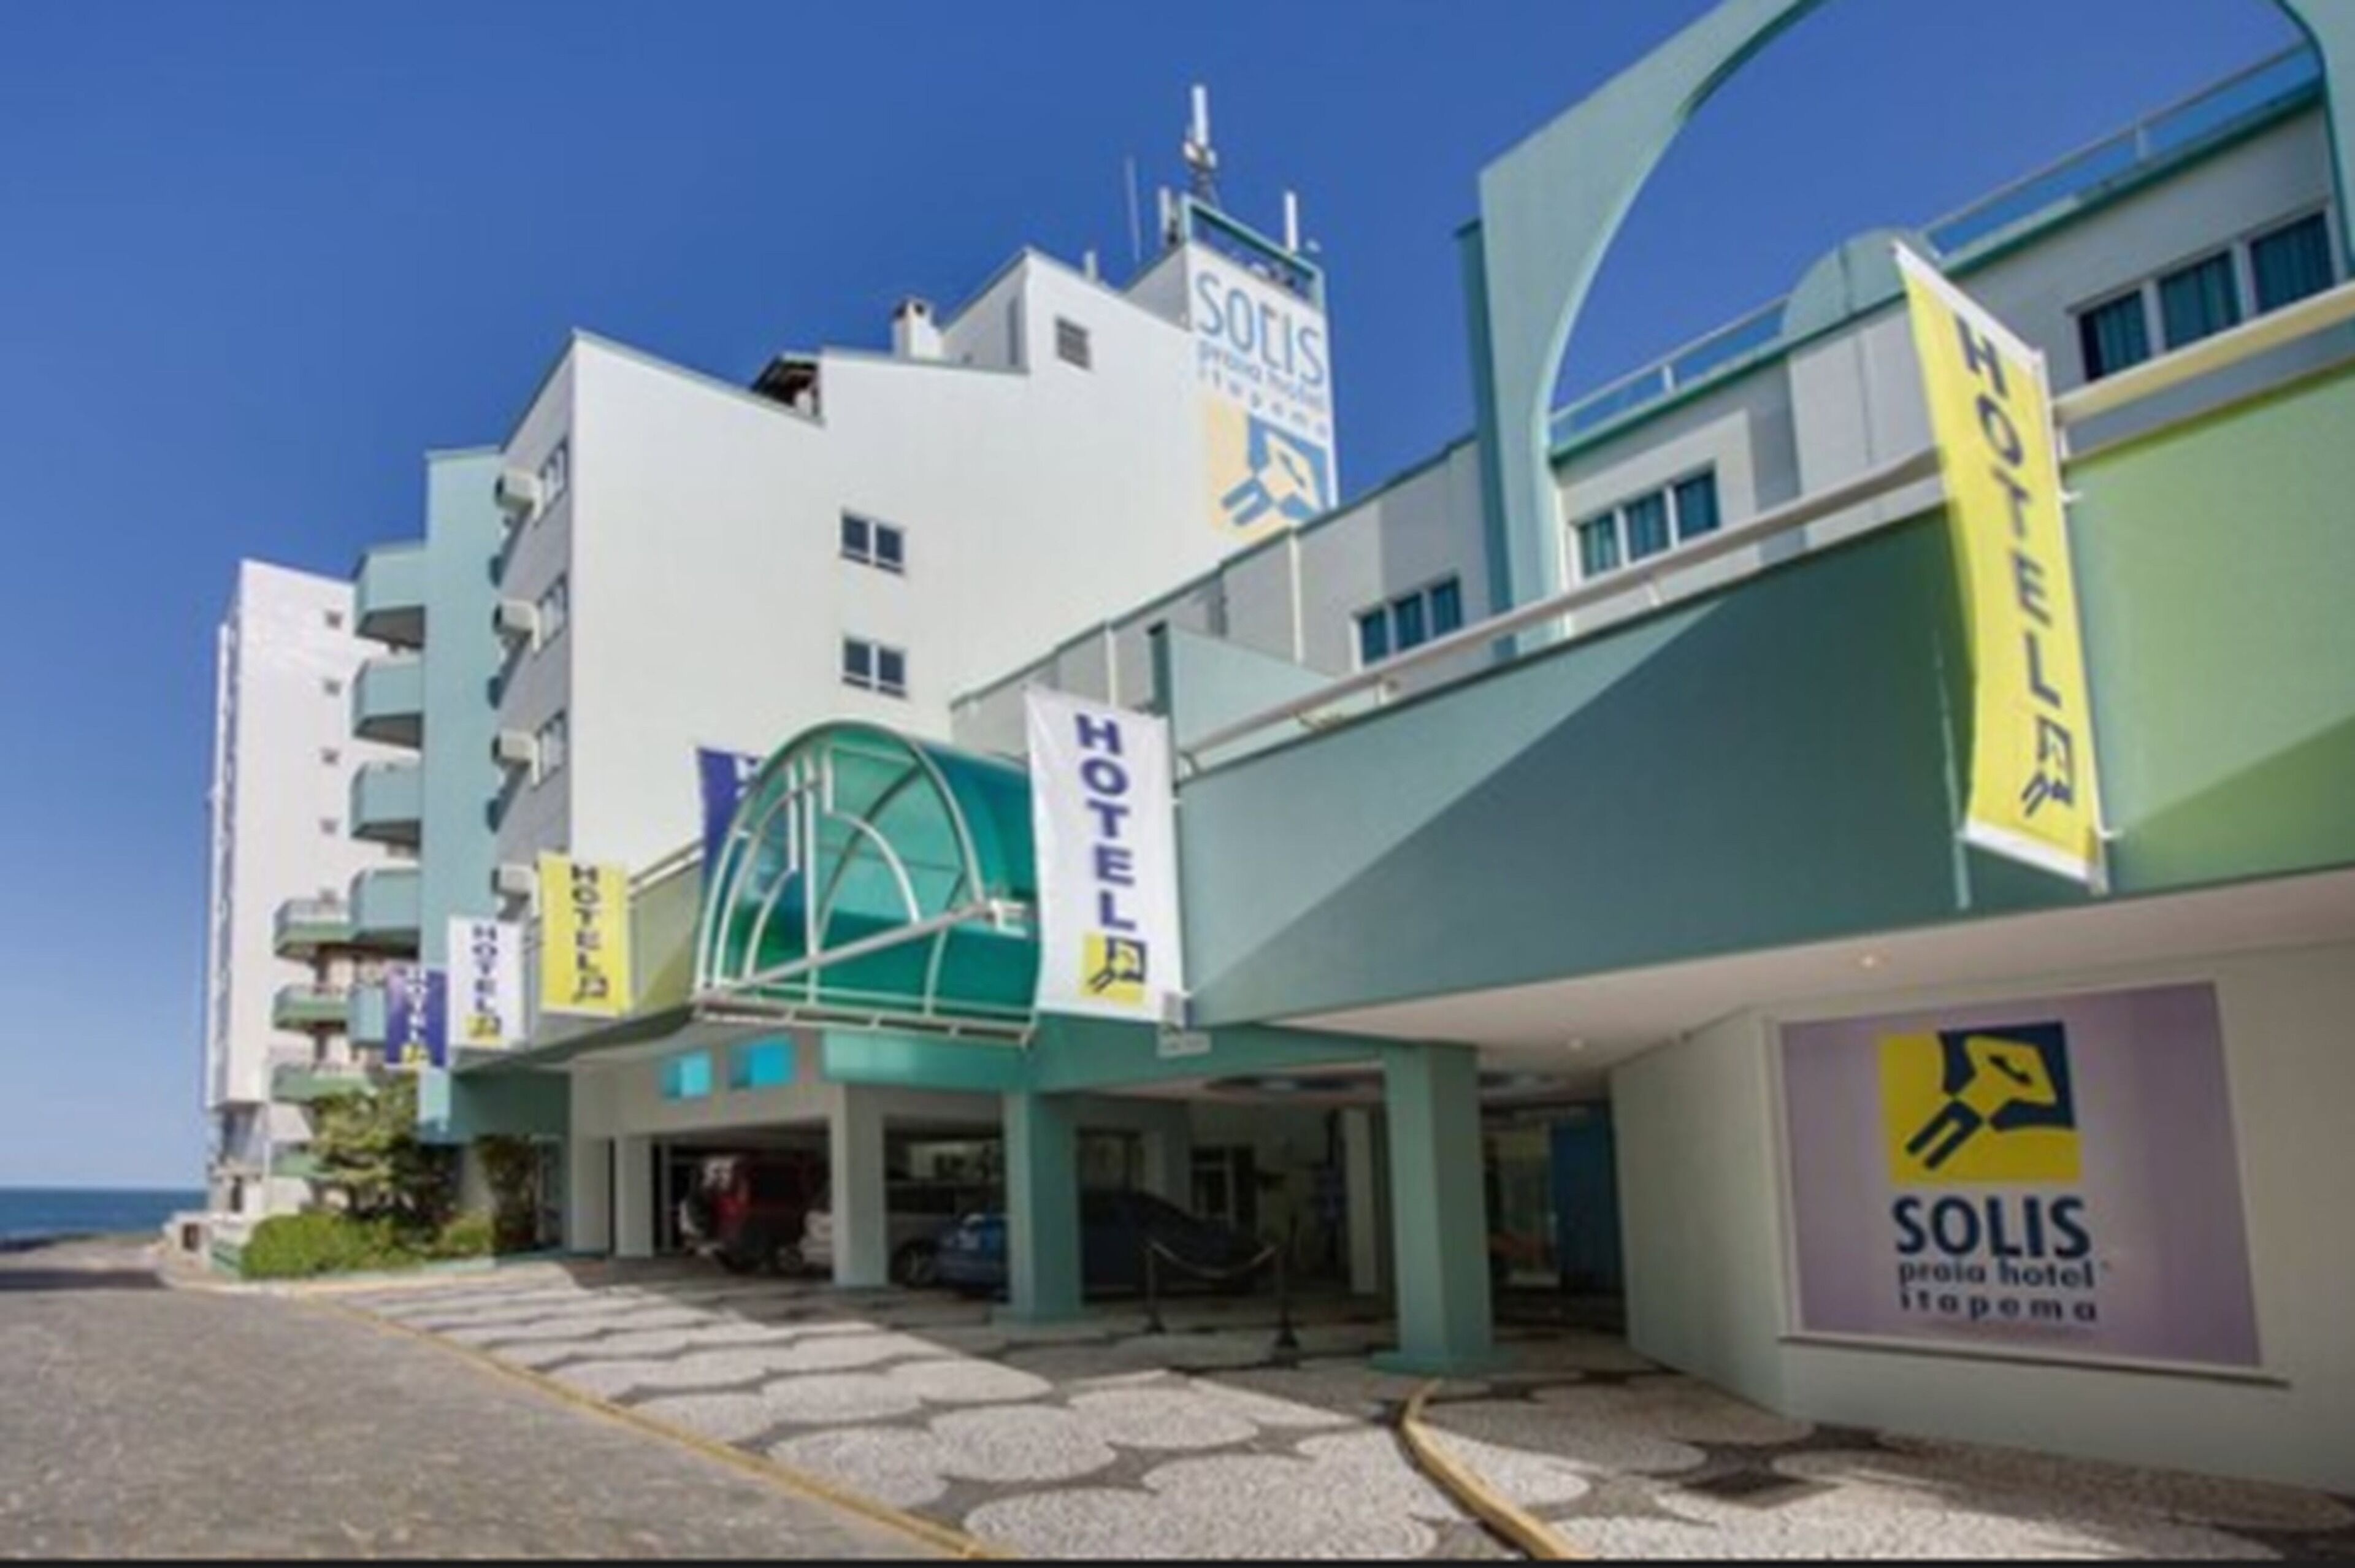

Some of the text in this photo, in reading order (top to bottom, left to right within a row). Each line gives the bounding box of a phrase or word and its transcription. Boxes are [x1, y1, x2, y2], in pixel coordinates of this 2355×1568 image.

[1197, 271, 1325, 385] SOLIS
[1954, 310, 2062, 710] HOTEL
[1074, 713, 1137, 931] HOTEL
[571, 863, 600, 975] HOTEL
[1892, 1195, 2091, 1260] SOLIS
[1899, 1255, 2095, 1289] praia hotel
[1899, 1288, 2096, 1321] itapema
